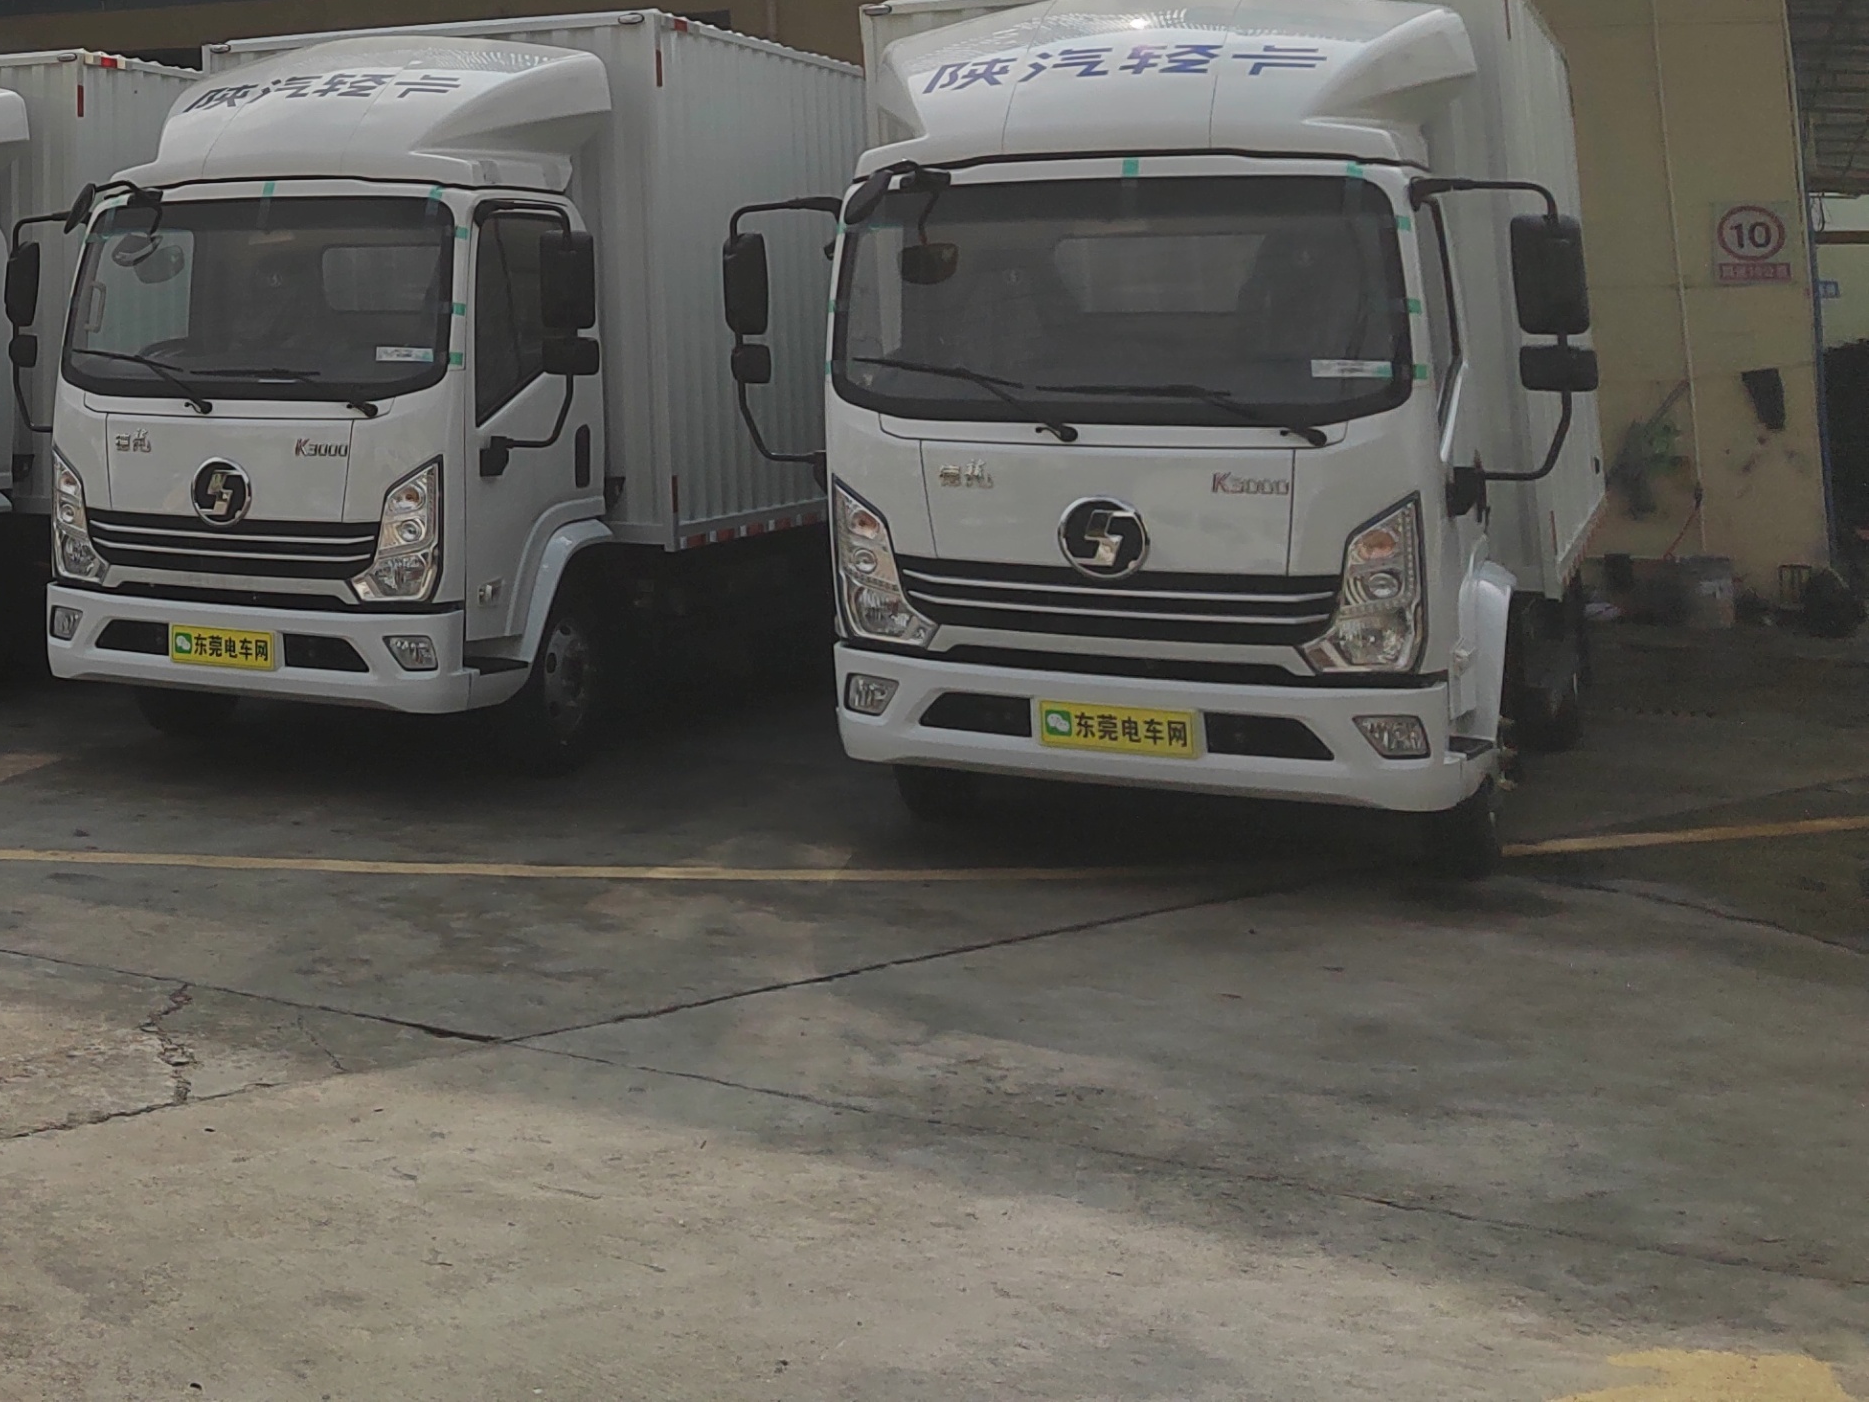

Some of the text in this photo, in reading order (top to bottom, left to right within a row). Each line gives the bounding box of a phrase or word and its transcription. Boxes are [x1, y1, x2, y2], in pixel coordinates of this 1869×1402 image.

[922, 43, 1328, 94] 陕汽轻卡
[1730, 222, 1772, 249] 10
[295, 438, 349, 457] K3000
[194, 633, 268, 662] 东莞电车网
[1074, 711, 1188, 748] 东莞电车网
